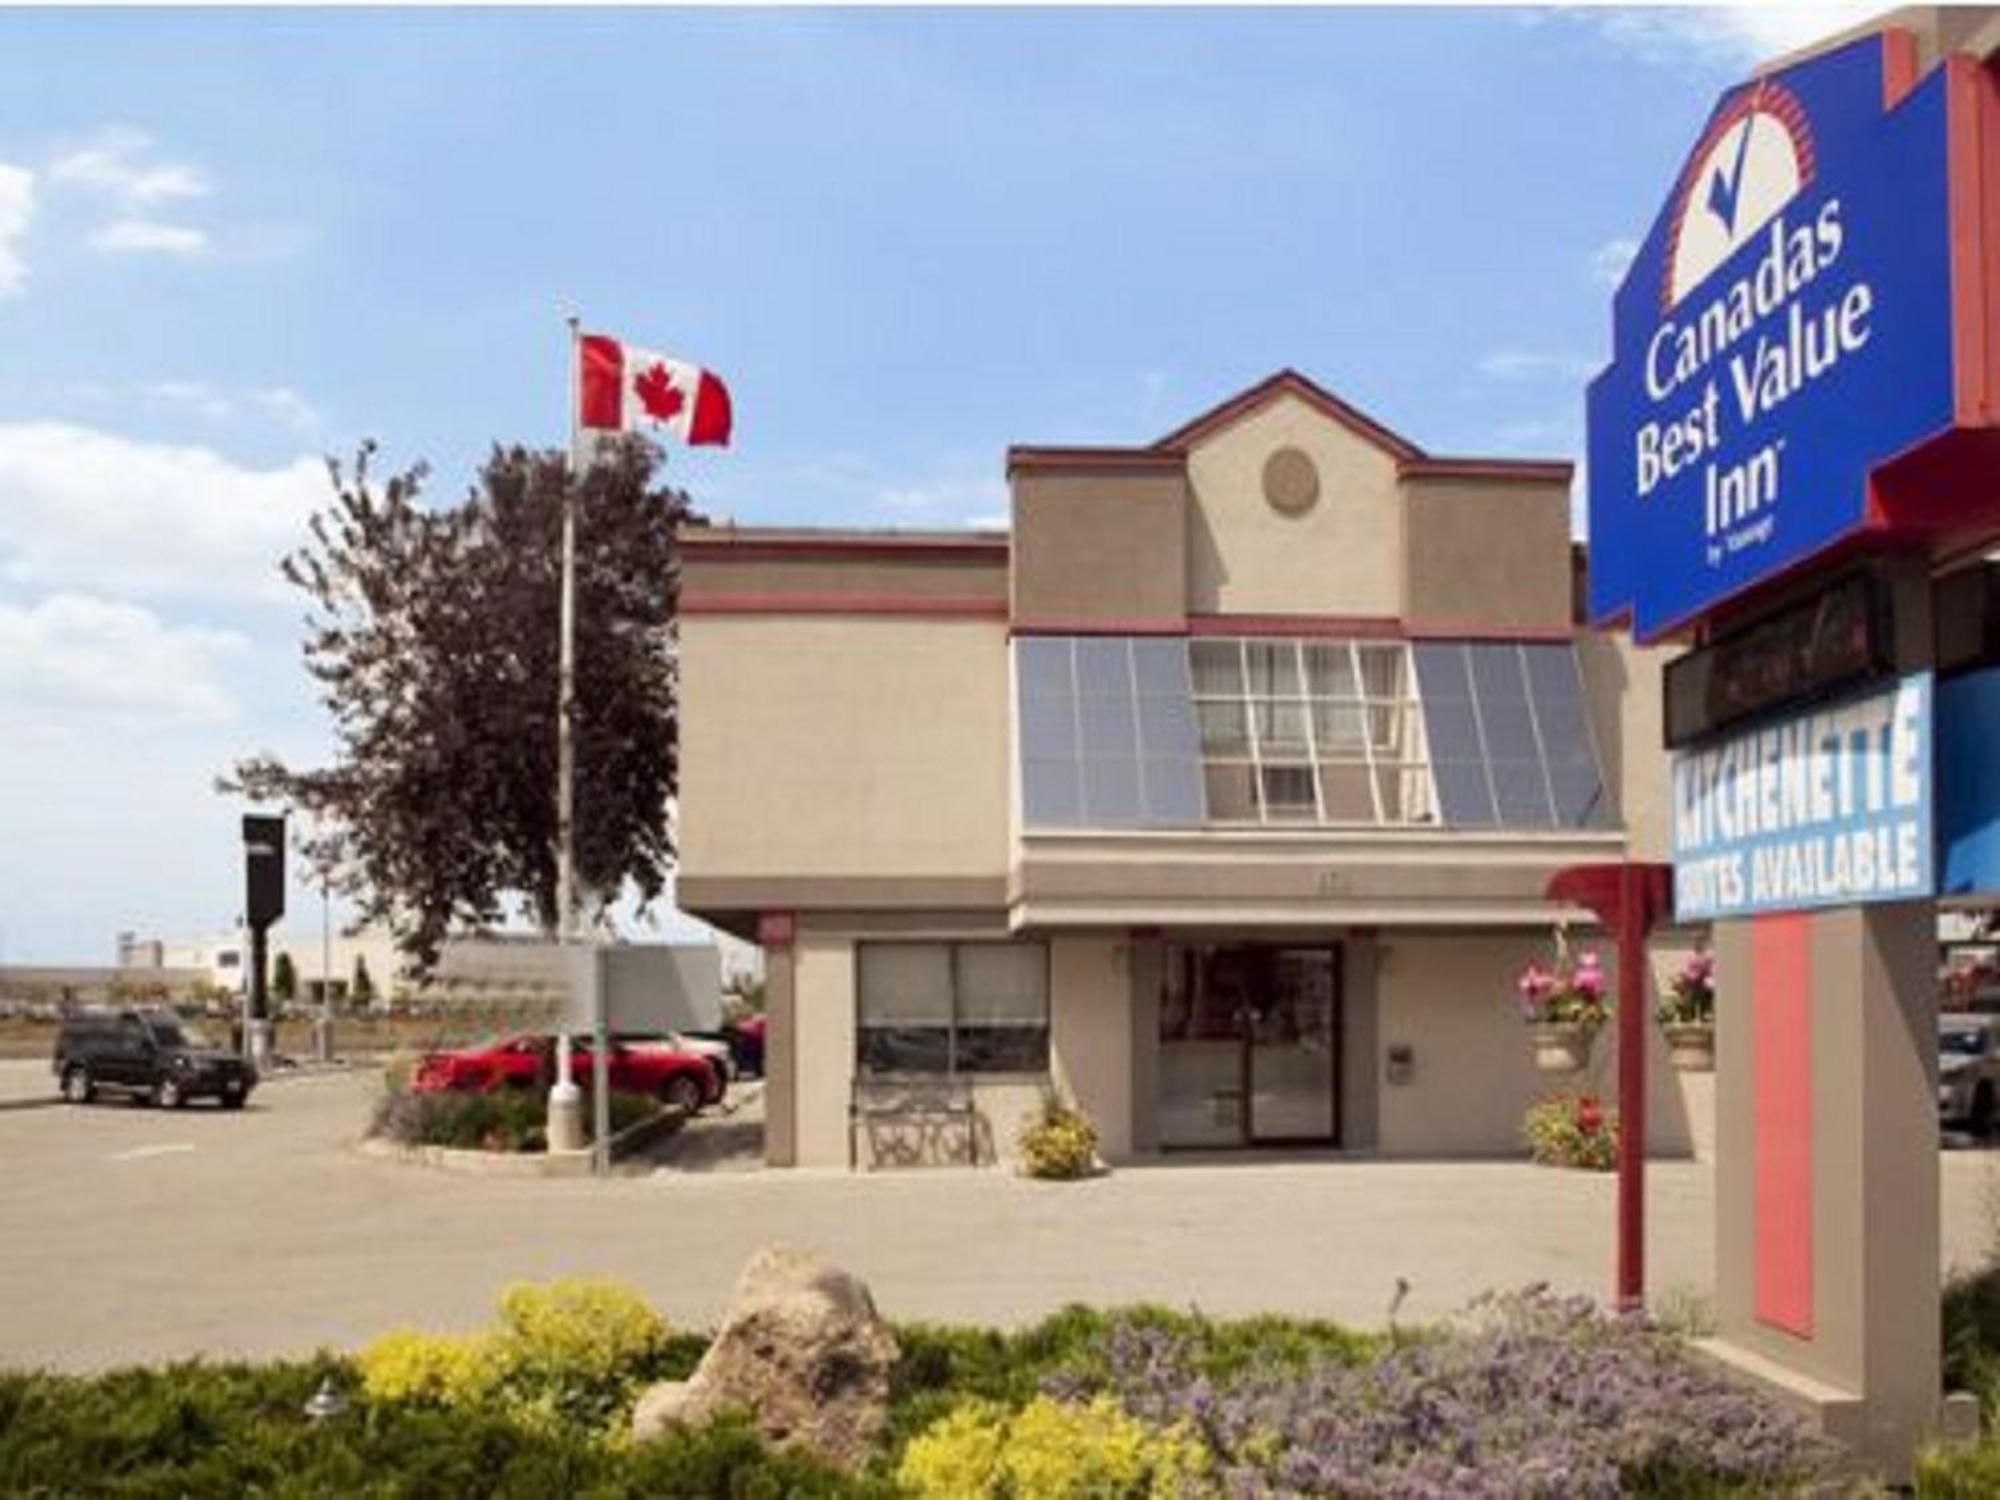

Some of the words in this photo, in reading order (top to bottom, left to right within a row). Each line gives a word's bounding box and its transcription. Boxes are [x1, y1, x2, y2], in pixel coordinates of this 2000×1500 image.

[1645, 199, 1844, 401] Canadas
[1637, 382, 1721, 496] Best
[1730, 283, 1874, 424] Value
[1706, 446, 1778, 535] Inn
[1752, 822, 1919, 902] AVAILABLE
